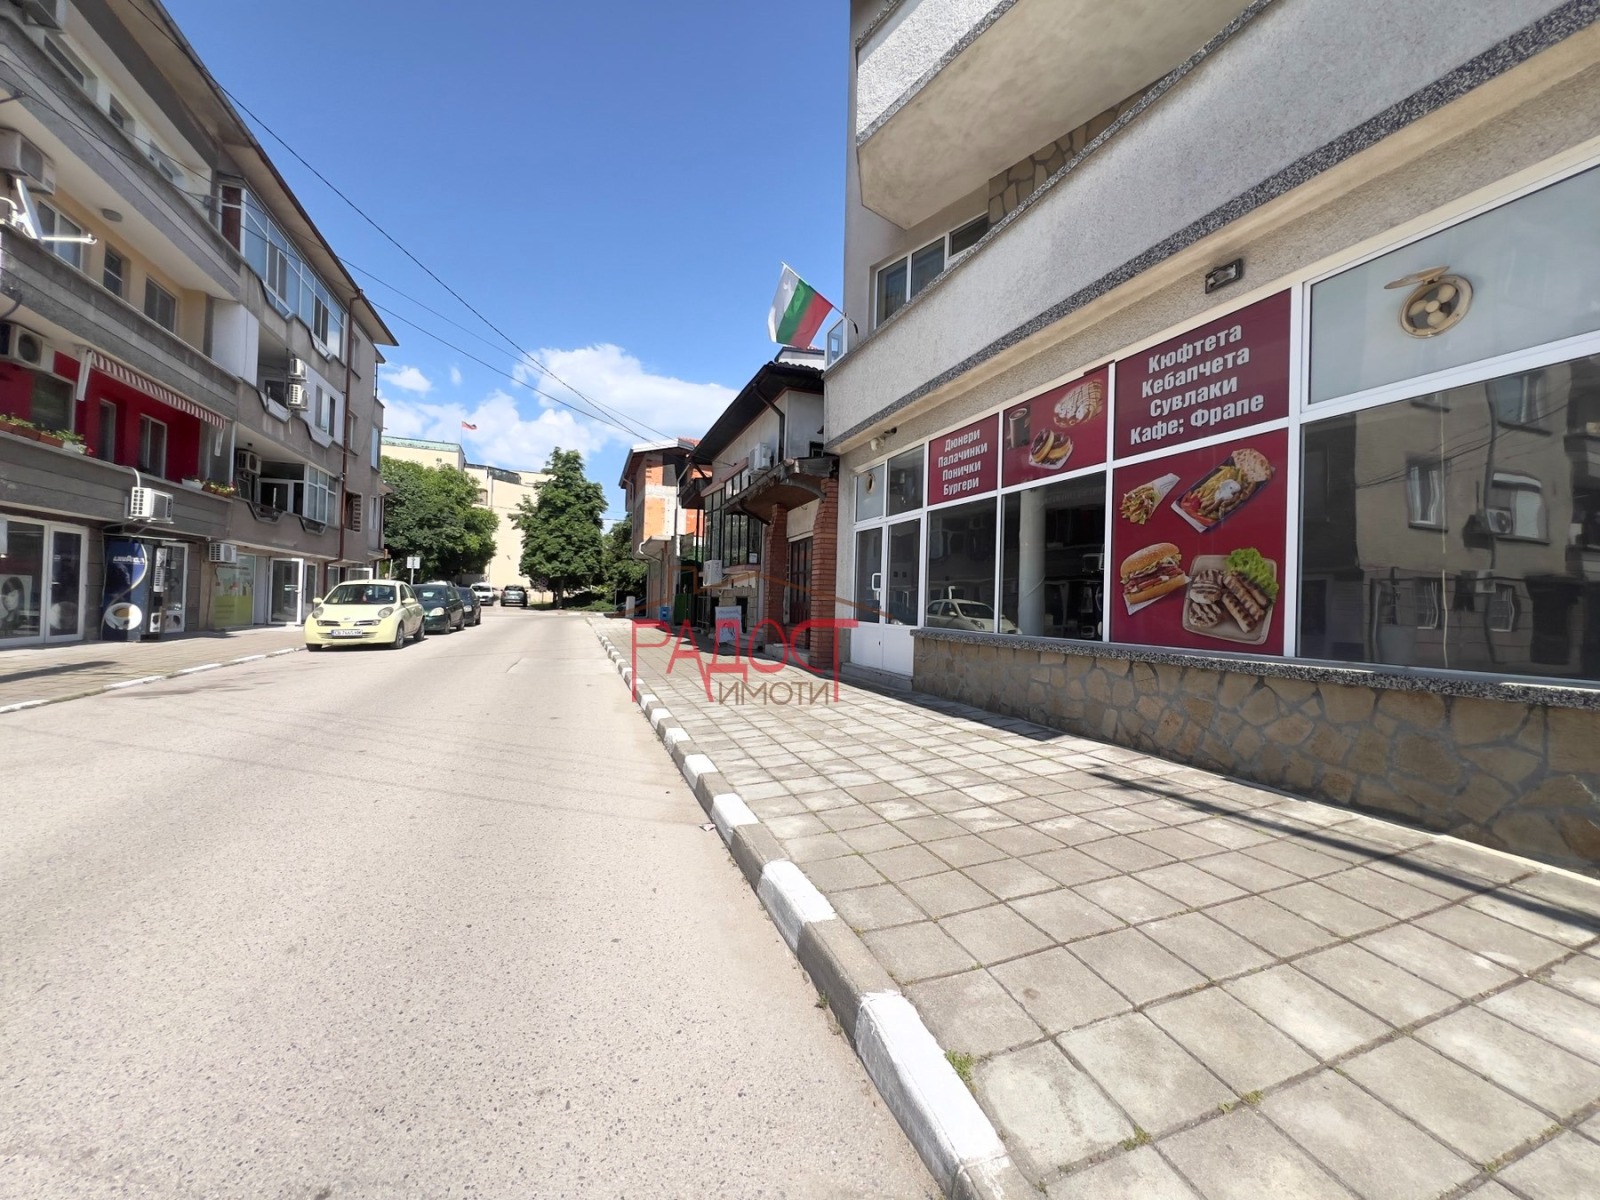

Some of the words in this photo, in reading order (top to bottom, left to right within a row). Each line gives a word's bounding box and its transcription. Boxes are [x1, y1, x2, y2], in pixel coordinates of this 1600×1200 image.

[1148, 325, 1242, 374] Кюфтета
[1142, 347, 1250, 398] Кебапчета
[1150, 377, 1238, 417] Сувлаки
[1130, 419, 1184, 445] Кафе;
[1190, 395, 1264, 427] Фрапе
[938, 443, 987, 468] Палачинки
[945, 429, 980, 452] Дюнери
[943, 461, 981, 481] Понички
[944, 477, 979, 496] Бургери
